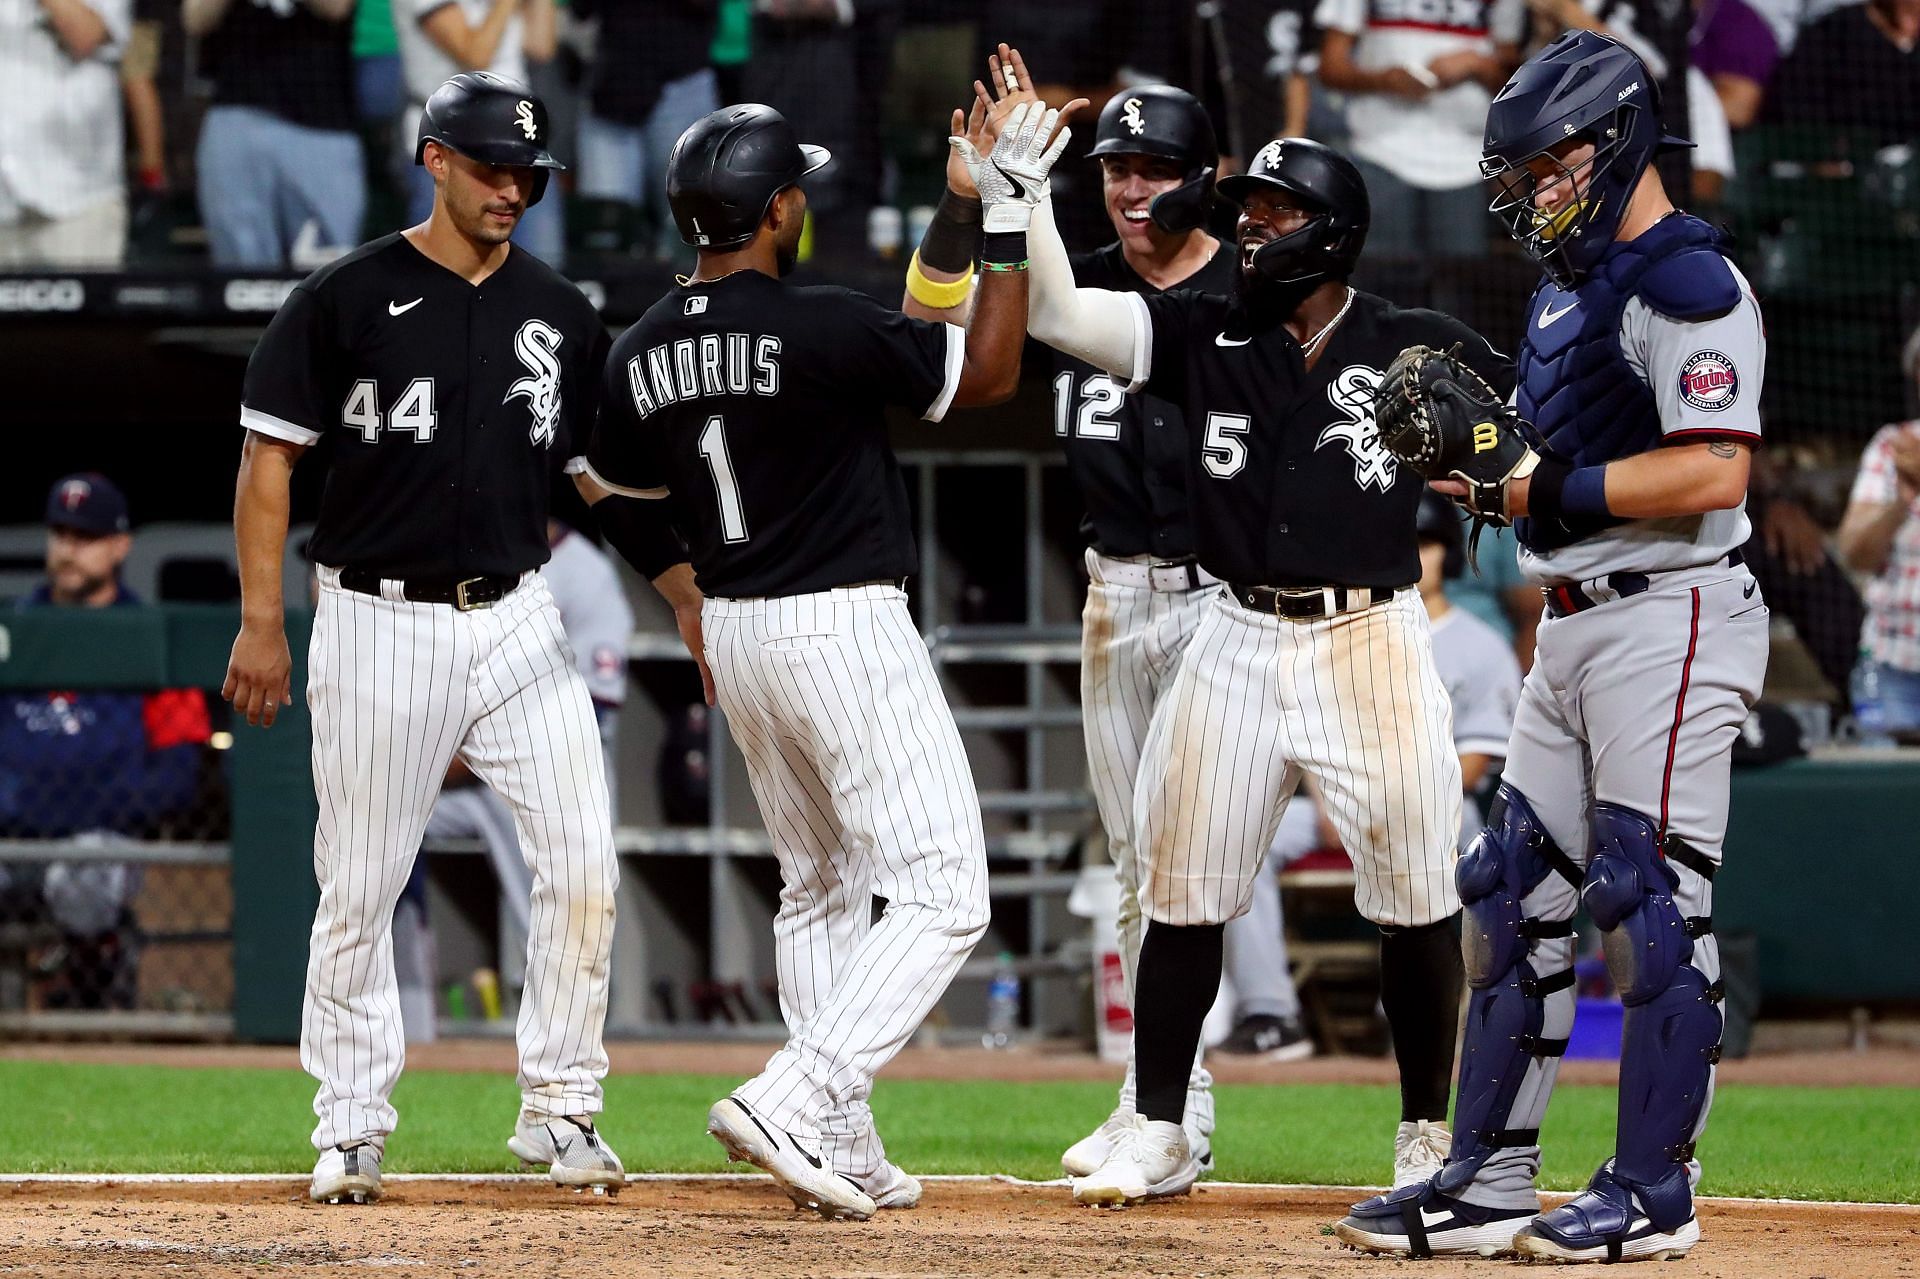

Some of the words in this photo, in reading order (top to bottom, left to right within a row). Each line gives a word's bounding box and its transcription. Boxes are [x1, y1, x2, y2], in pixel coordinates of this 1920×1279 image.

[0, 279, 84, 312] EICO
[627, 333, 782, 420] ANDRUS
[1682, 369, 1735, 394] Twins
[1684, 353, 1733, 372] MINNESOTA
[342, 377, 438, 444] 44
[1053, 371, 1125, 441] 12
[1686, 394, 1720, 408] BASEBALL
[1720, 393, 1734, 407] CLUB
[1201, 411, 1251, 479] 5
[698, 415, 749, 544] 1
